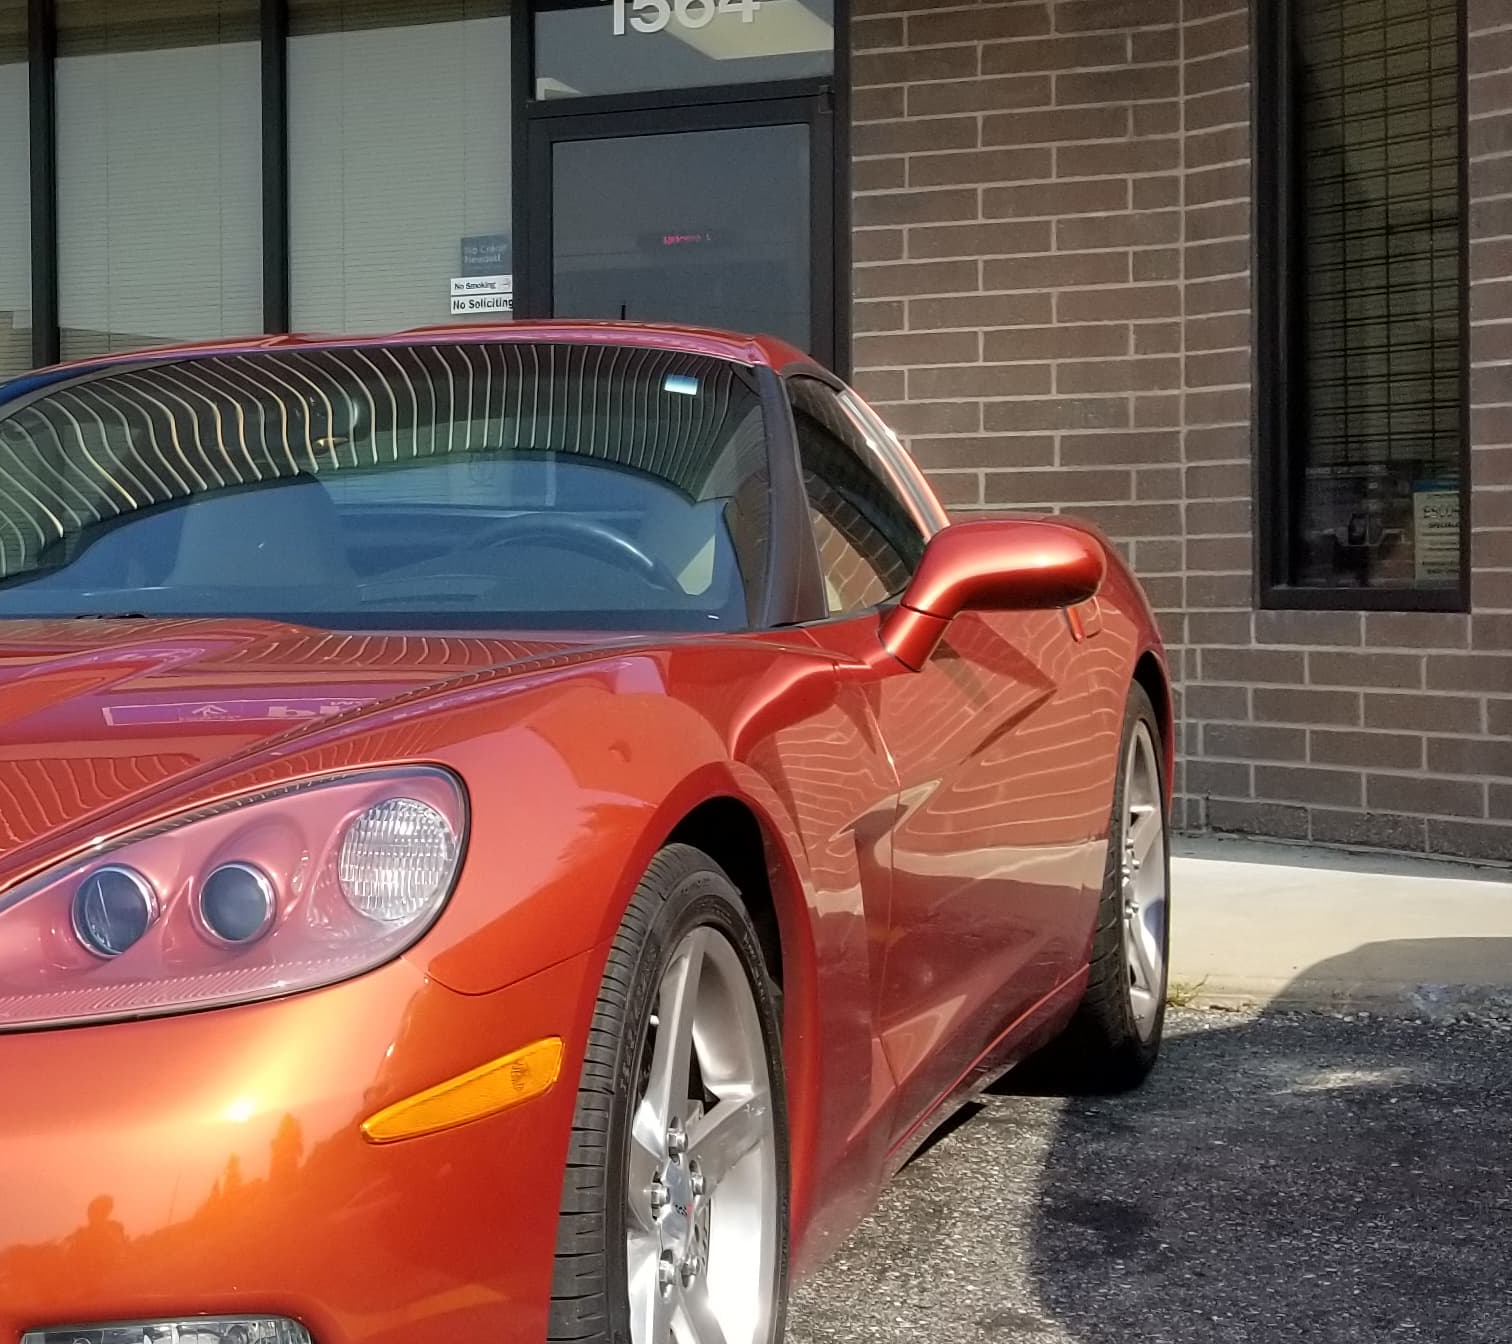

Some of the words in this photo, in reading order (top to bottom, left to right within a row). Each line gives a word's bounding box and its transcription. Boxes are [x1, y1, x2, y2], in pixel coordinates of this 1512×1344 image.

[454, 283, 464, 291] No
[466, 281, 496, 290] Smoking
[453, 299, 466, 310] No
[468, 297, 513, 309] Soliciting
